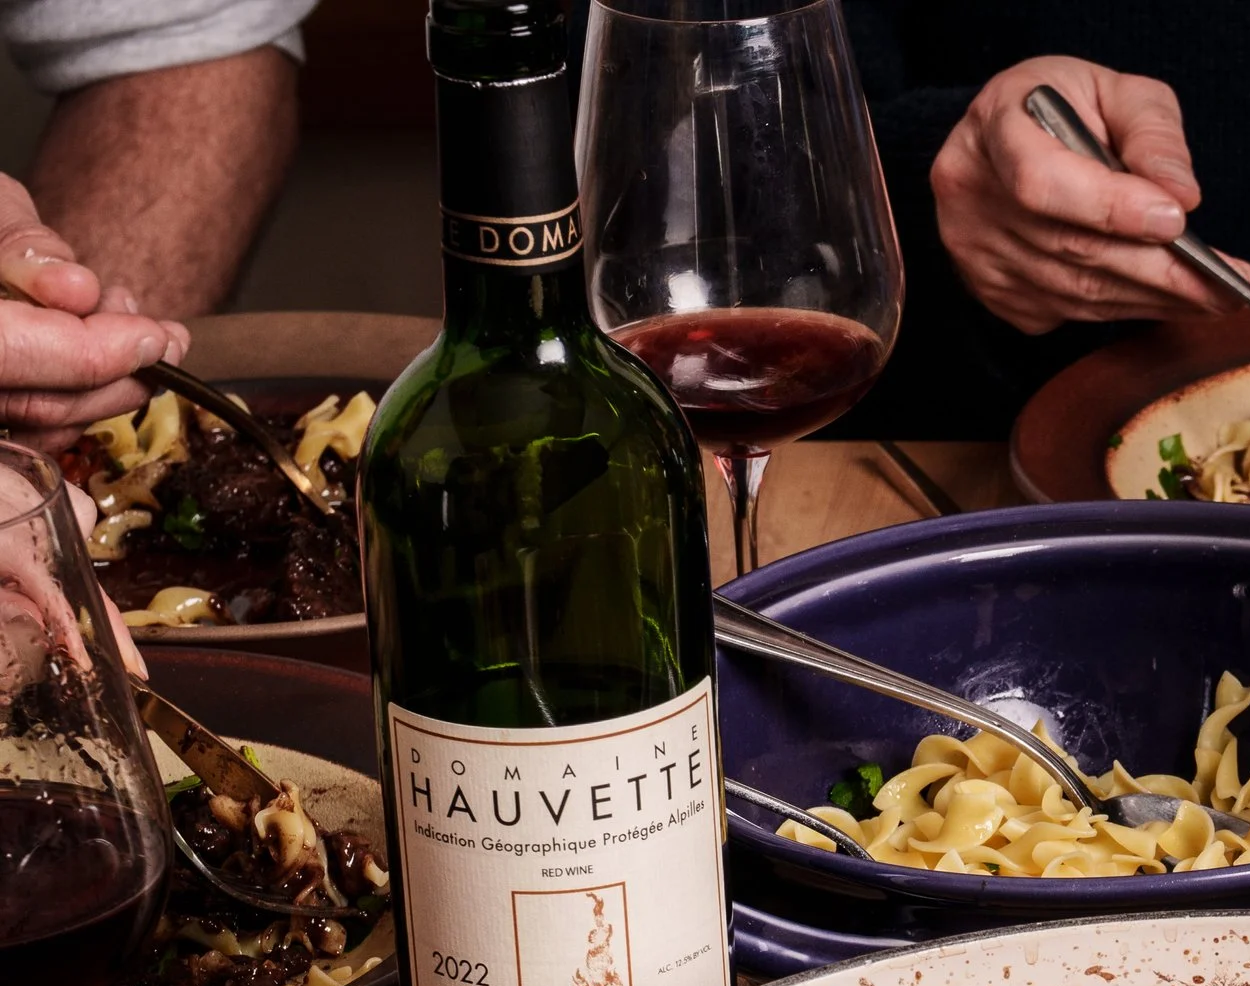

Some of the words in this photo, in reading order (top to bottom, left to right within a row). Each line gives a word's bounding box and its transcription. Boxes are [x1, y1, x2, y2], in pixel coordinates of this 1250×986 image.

[411, 724, 698, 781] DOMAINE
[410, 749, 702, 827] HAUVETTE
[414, 819, 476, 849] Indication
[481, 836, 597, 857] Géographique
[603, 820, 664, 846] Protégée
[667, 800, 705, 828] Alpilles
[541, 867, 564, 878] RED
[564, 864, 594, 877] WINE
[432, 950, 490, 986] 2022
